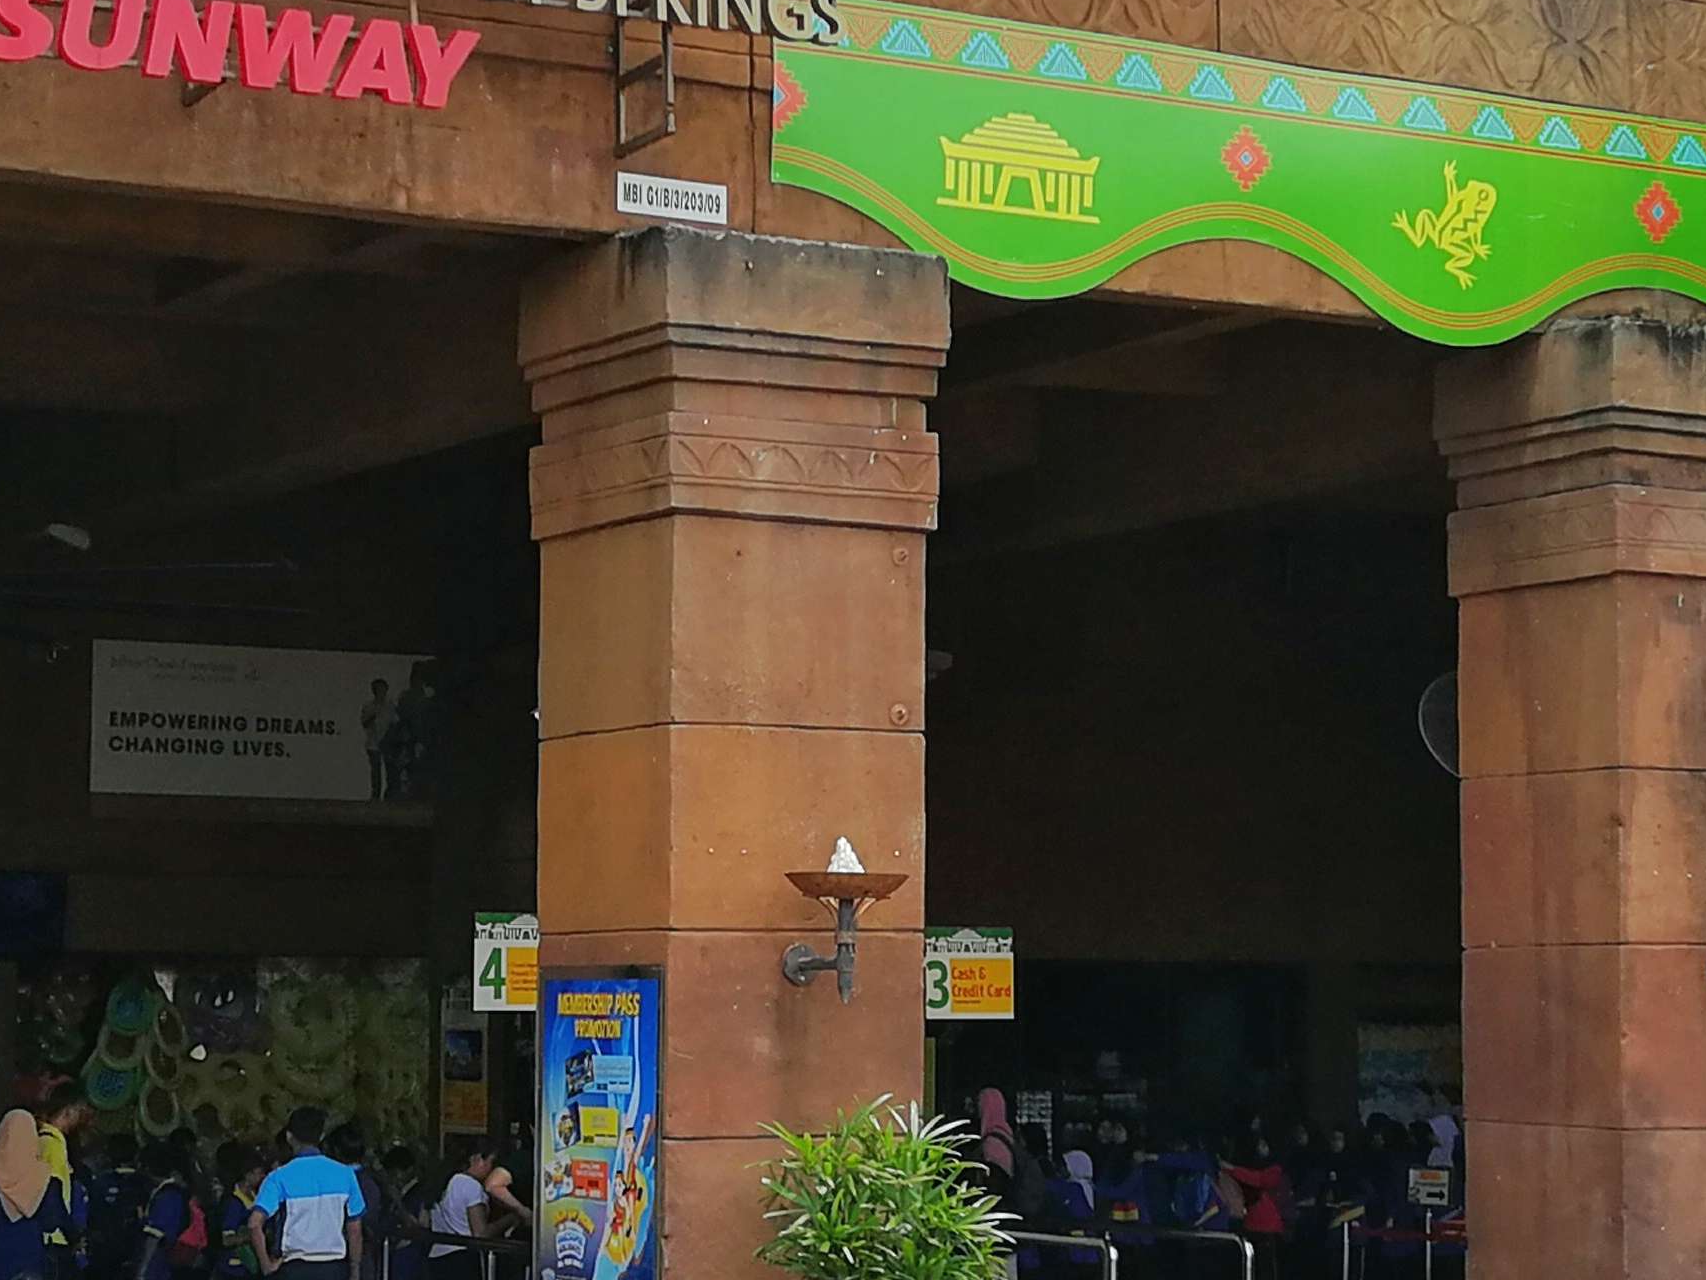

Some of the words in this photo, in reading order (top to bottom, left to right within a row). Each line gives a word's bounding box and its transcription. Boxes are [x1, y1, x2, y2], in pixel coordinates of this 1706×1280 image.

[622, 182, 642, 205] MBI
[108, 711, 248, 733] EMPOWERING
[108, 736, 225, 755] CHANGING
[232, 740, 292, 758] LIVES.
[479, 947, 506, 1000] 4
[926, 960, 949, 1008] 3
[952, 966, 976, 980] Cash
[952, 984, 983, 997] Credit
[987, 984, 1011, 997] Card
[615, 992, 640, 1017] PASS
